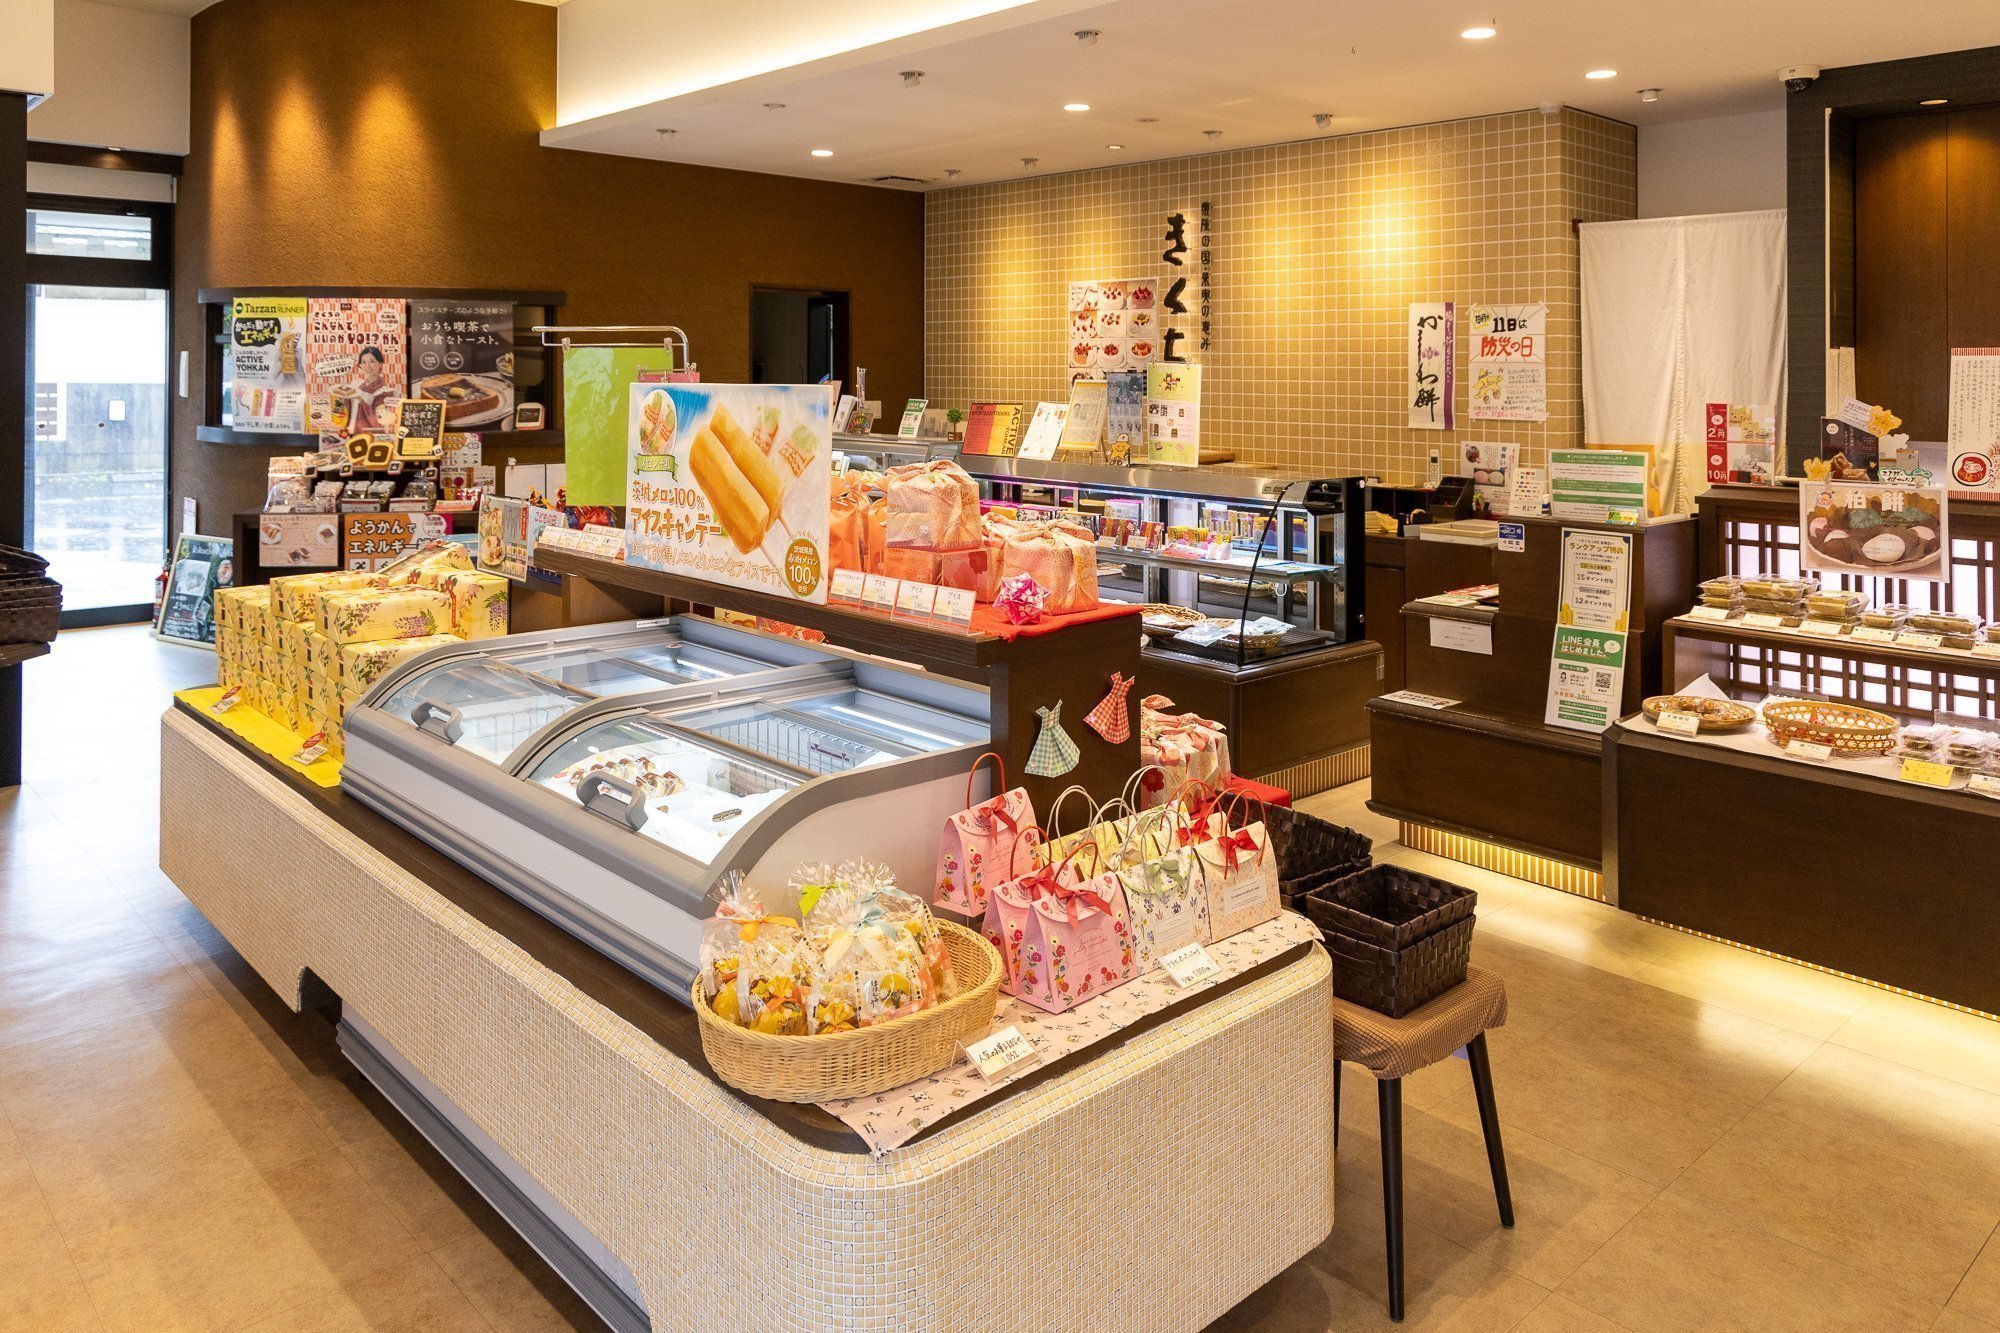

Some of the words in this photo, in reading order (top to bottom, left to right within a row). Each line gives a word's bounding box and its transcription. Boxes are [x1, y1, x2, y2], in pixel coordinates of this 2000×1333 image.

[245, 304, 276, 313] Tarzan
[421, 321, 490, 332] おうち喫茶で
[1492, 316, 1527, 333] 11日は
[421, 334, 499, 345] 小倉なトースト。
[1481, 336, 1533, 358] 防災の日
[1006, 406, 1021, 455] ACTIVE
[1708, 428, 1725, 438] 2円
[1001, 427, 1009, 455] YOHKAN
[1708, 470, 1726, 480] 10円
[632, 480, 705, 510] 茨城メロン100%
[349, 520, 416, 535] ようかんで
[631, 508, 722, 546] アイスキャンデー
[1569, 543, 1624, 554] ランクアップ特典
[789, 565, 816, 586] 100%
[875, 579, 886, 587] アイス
[911, 586, 923, 594] アイス
[948, 592, 961, 600] アイス
[1561, 644, 1606, 658] はじめました。
